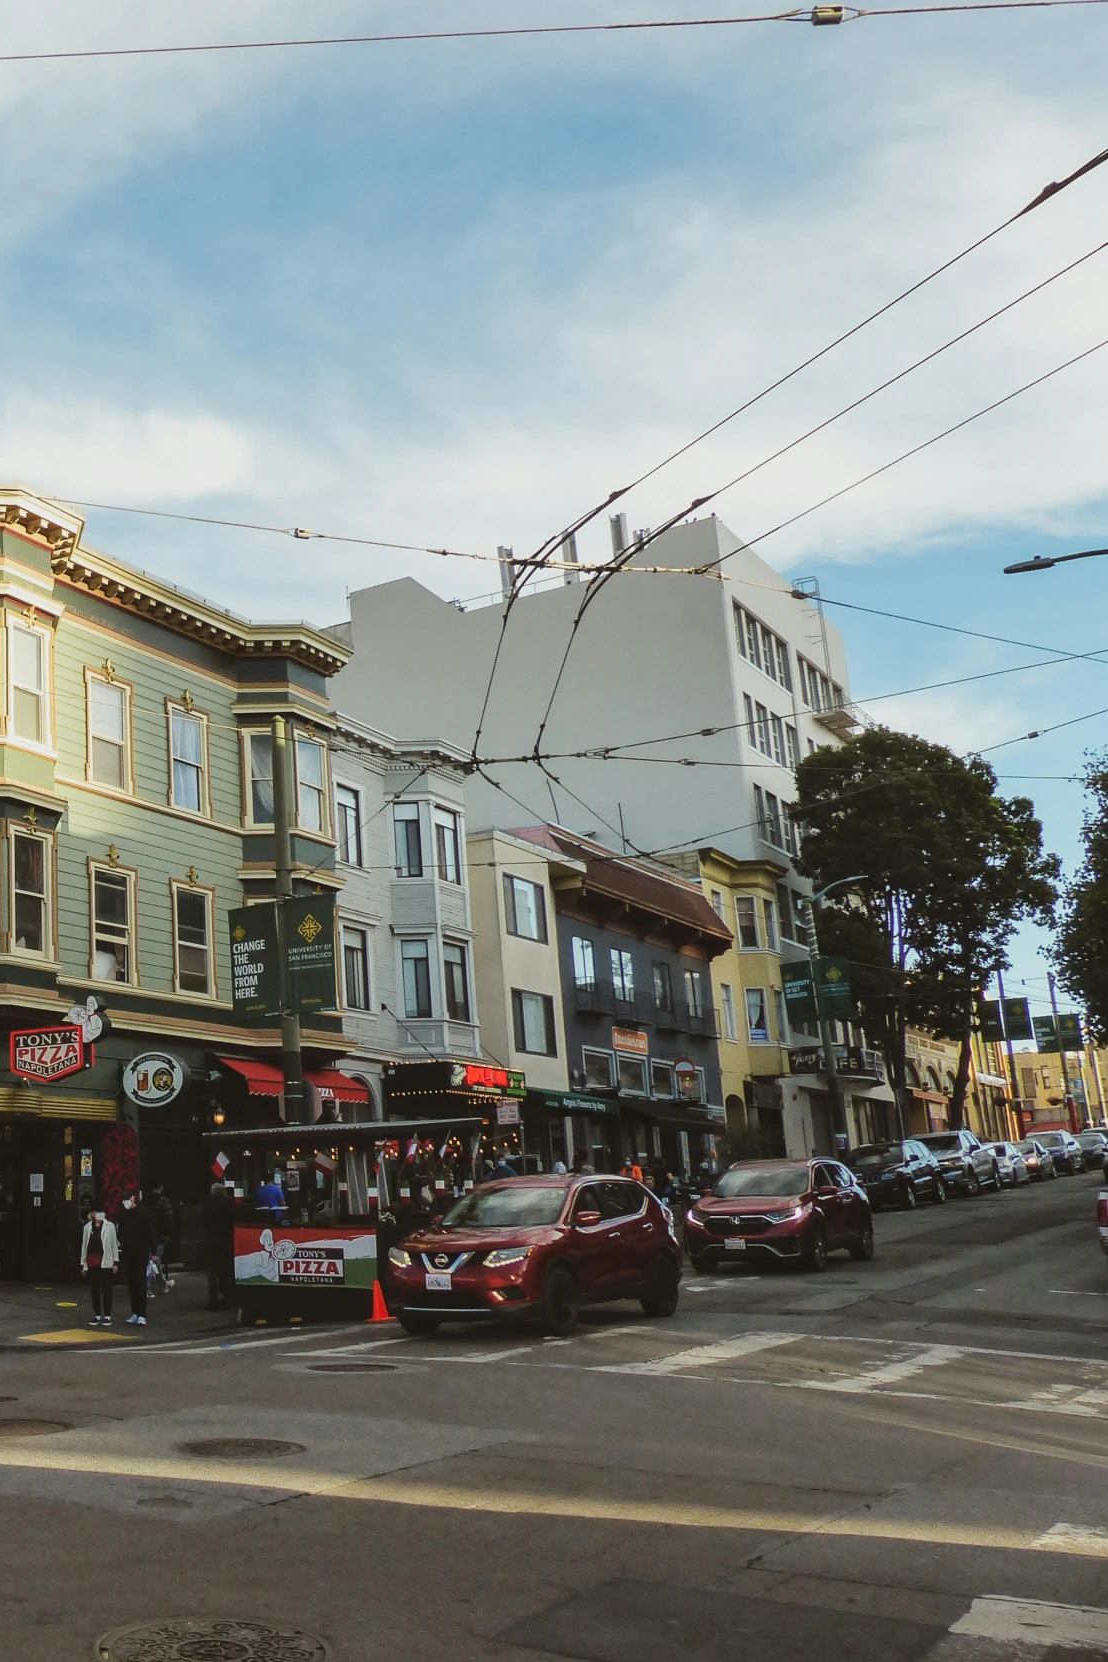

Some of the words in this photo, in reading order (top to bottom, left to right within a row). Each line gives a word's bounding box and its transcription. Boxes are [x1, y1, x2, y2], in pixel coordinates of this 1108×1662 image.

[233, 940, 266, 954] CHANGE
[288, 945, 322, 954] UNIVERSITY
[233, 954, 249, 966] THE
[301, 952, 332, 960] FRANCISCO
[234, 963, 264, 977] WORLD
[234, 975, 258, 988] FROM
[235, 987, 258, 999] HERE.
[16, 1031, 79, 1047] TONY'S
[18, 1044, 78, 1064] PIZZA
[18, 1057, 77, 1076] NAPOLETANA
[297, 1250, 326, 1258] TONY'S
[283, 1261, 340, 1275] PIZZA
